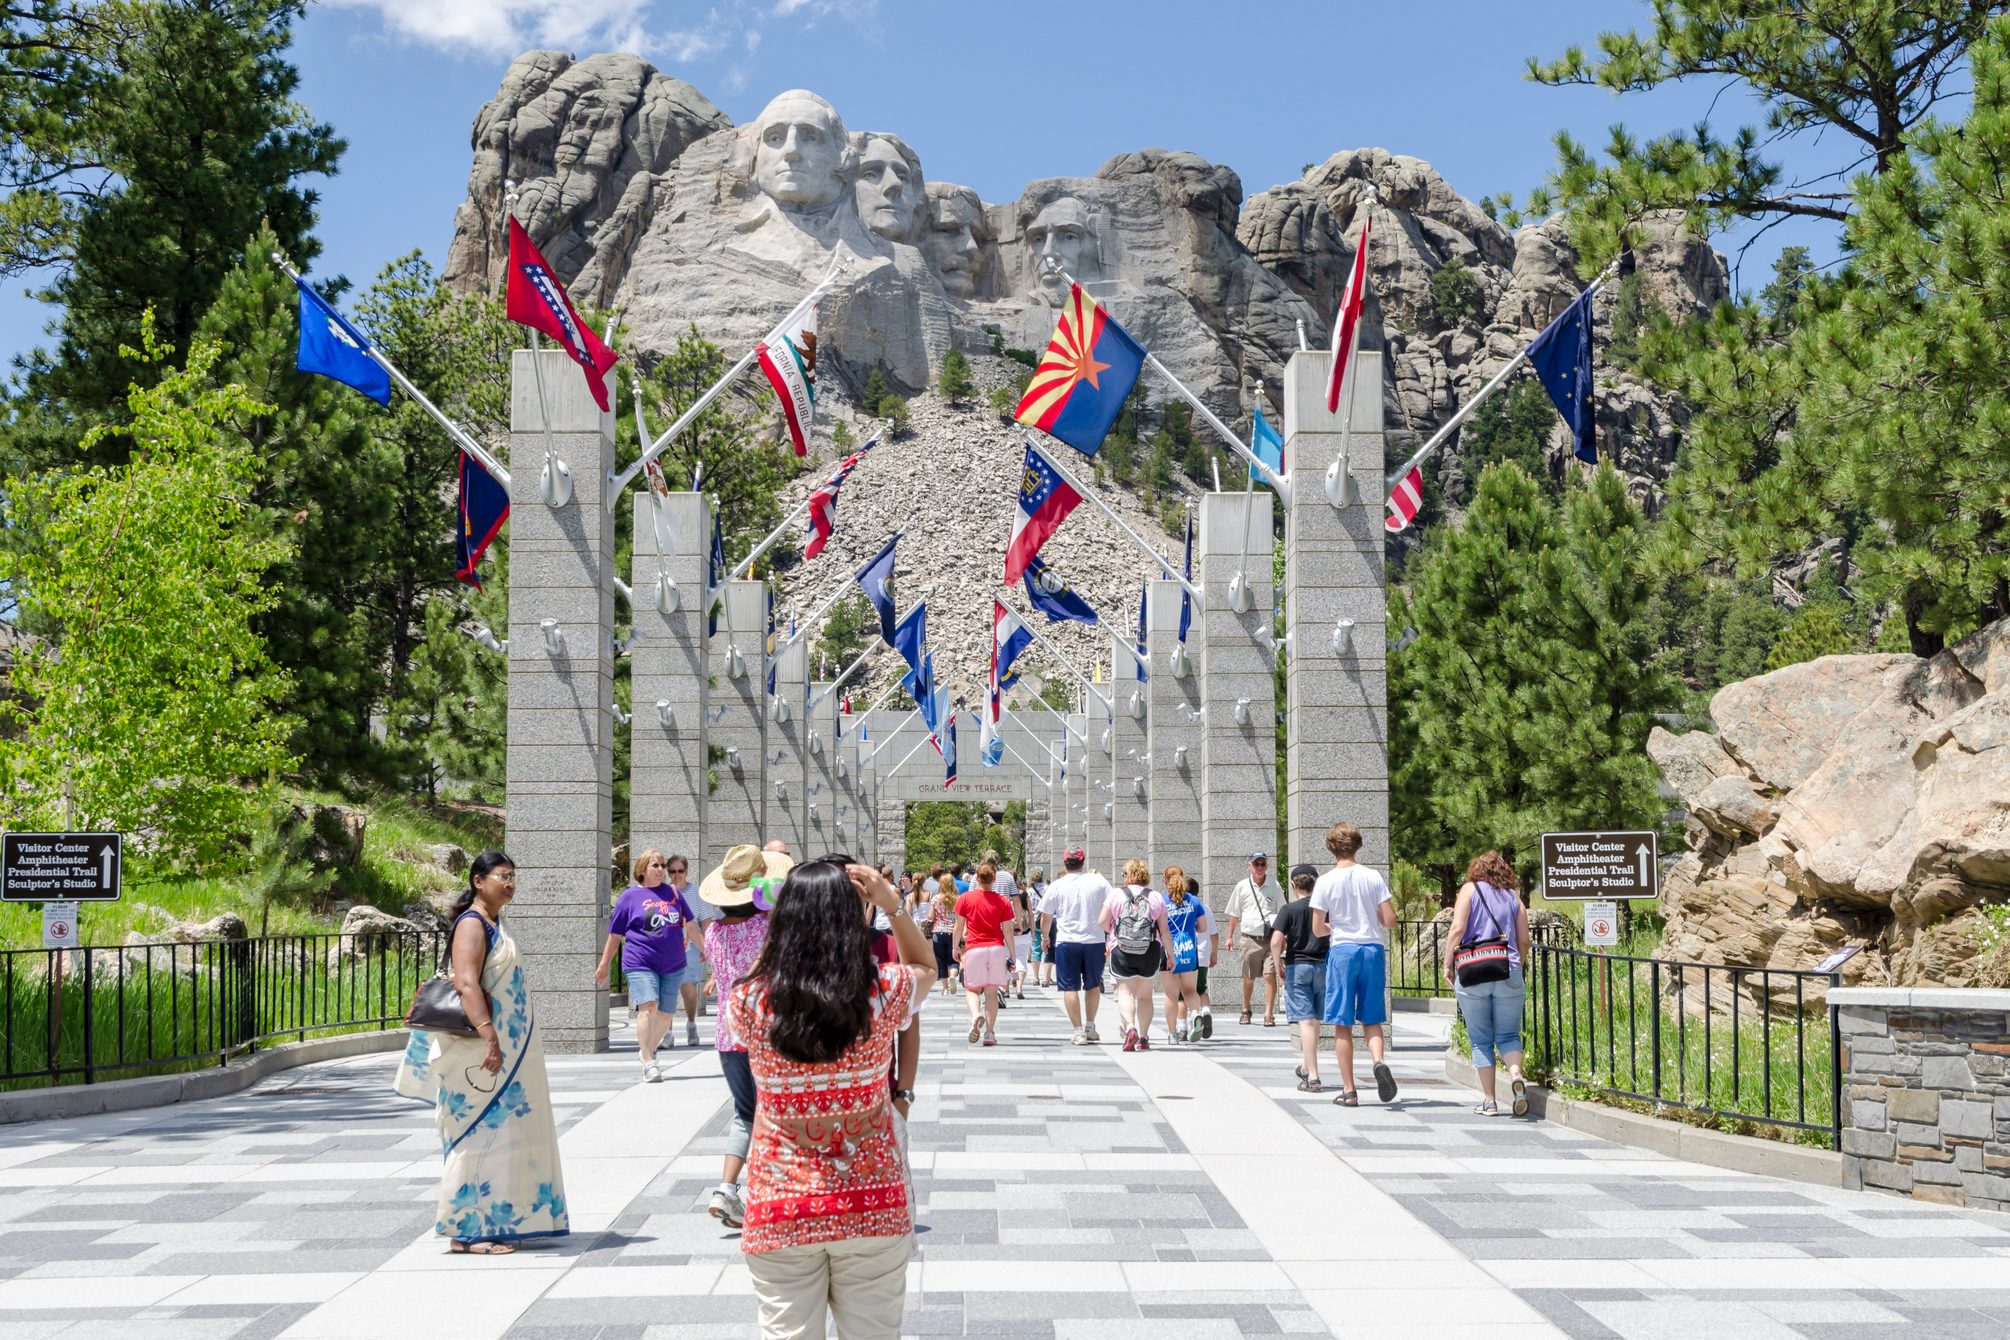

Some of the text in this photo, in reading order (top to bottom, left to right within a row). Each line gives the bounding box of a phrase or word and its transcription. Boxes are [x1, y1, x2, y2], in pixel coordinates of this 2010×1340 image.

[951, 784, 971, 793] VIEW
[974, 784, 1013, 793] TERRACE
[17, 843, 90, 853] Visitor Center
[1555, 842, 1625, 852] Visitor Center
[17, 855, 89, 867] Amphitheater
[1556, 854, 1625, 866] Amphitheater
[7, 867, 98, 877] Presidential Trail
[1548, 865, 1635, 876] Presidential Trail
[8, 879, 97, 891] Sculptor's Studio
[1549, 877, 1635, 890] Sculptor's Studio
[650, 911, 680, 928] ONE
